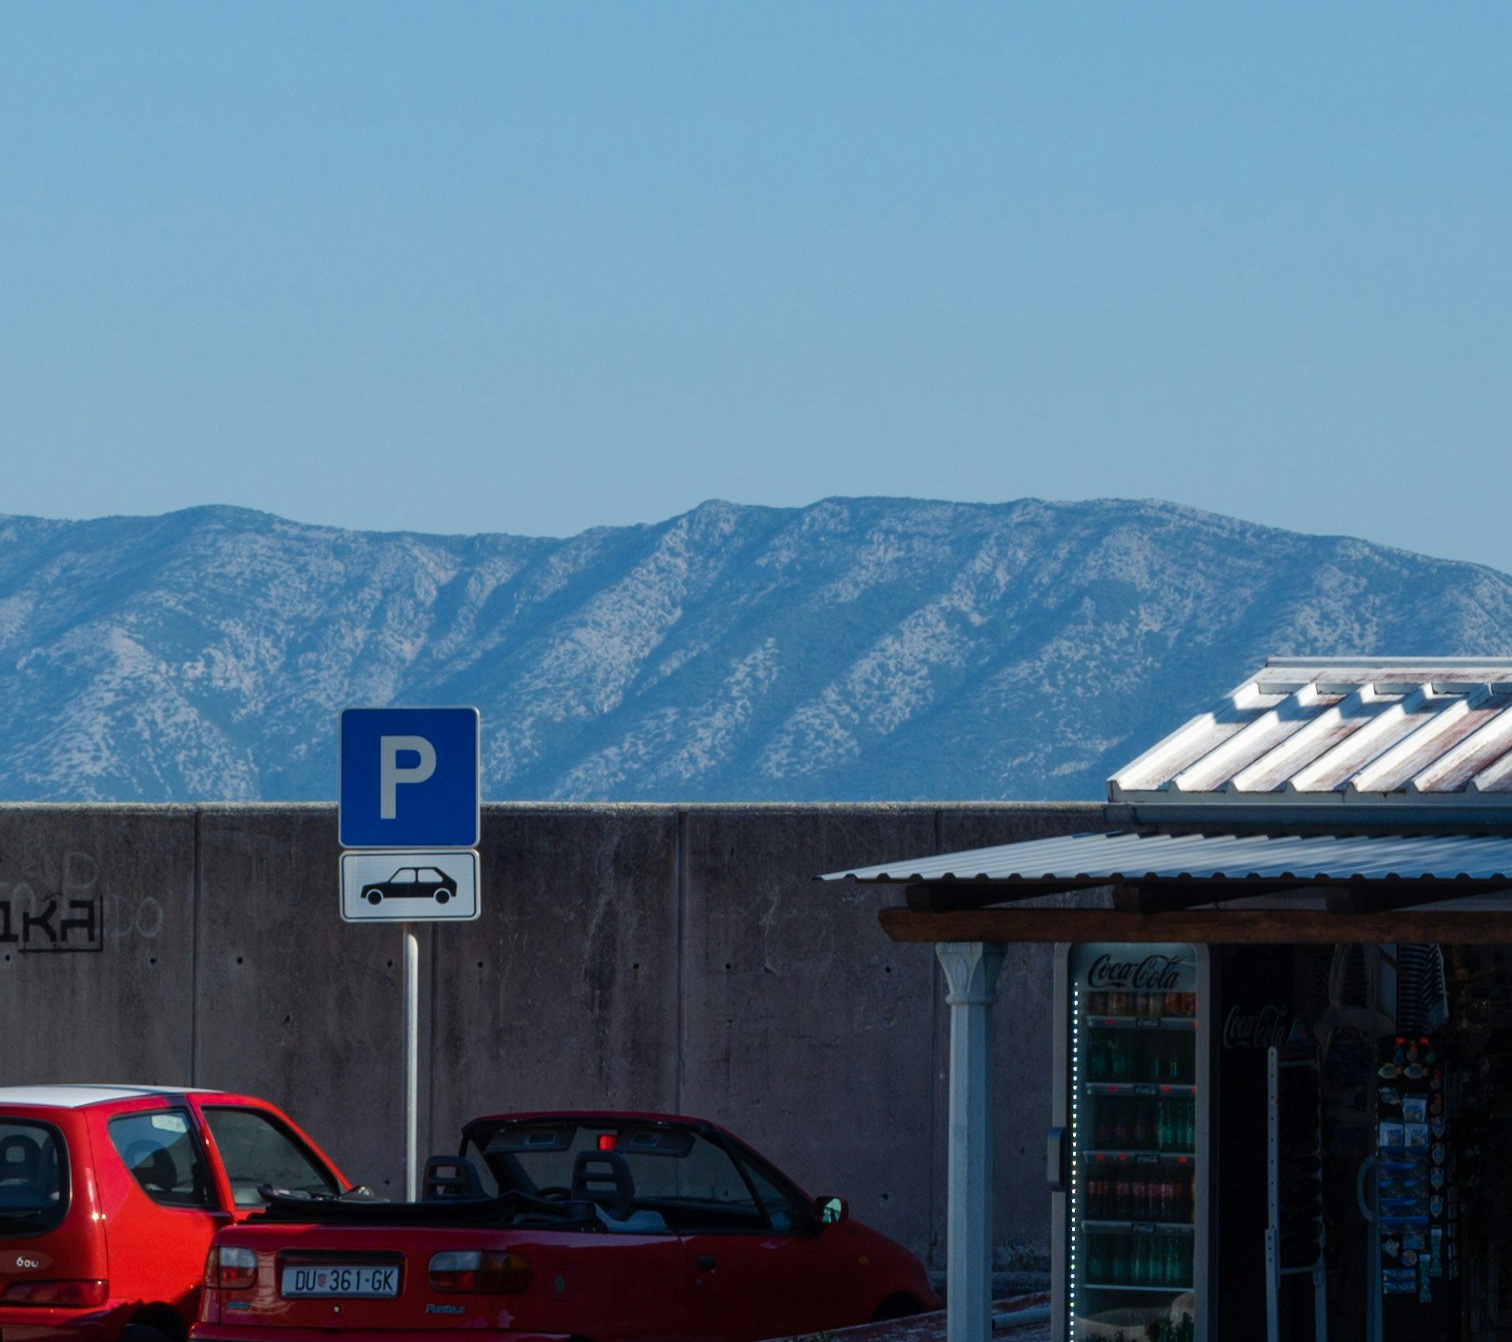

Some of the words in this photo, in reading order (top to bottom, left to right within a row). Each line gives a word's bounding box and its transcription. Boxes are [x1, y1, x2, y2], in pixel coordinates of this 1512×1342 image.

[379, 734, 437, 820] P
[1088, 954, 1183, 990] Coca-Cola
[295, 1271, 316, 1291] DU
[329, 1270, 394, 1291] 361-GK
